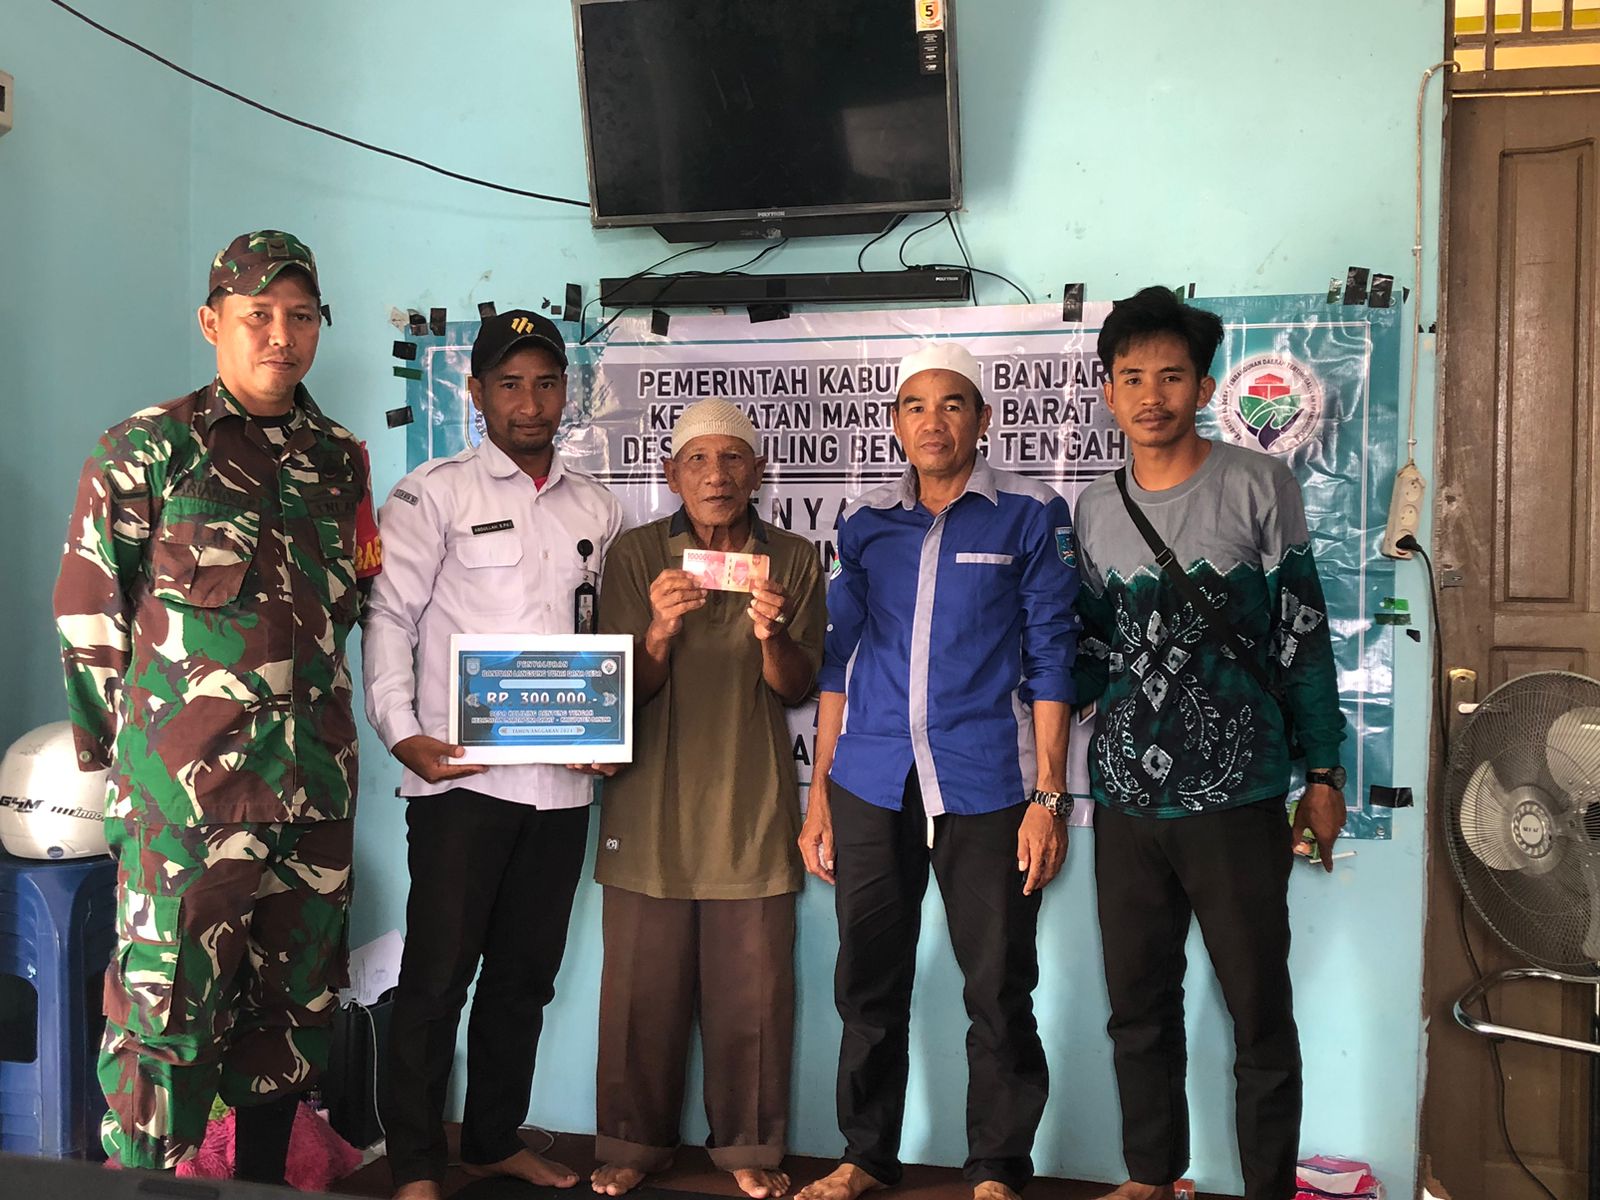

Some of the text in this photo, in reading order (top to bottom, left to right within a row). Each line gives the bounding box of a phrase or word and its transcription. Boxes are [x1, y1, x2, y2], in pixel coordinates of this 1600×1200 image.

[925, 5, 933, 17] 5
[639, 368, 807, 397] PEMERINTAH
[994, 360, 1107, 390] BANJAR
[650, 402, 811, 430] KEATAN
[1002, 397, 1094, 426] BARAT
[623, 436, 672, 464] DES
[850, 434, 988, 463] BENG
[1000, 430, 1126, 461] TENGAH
